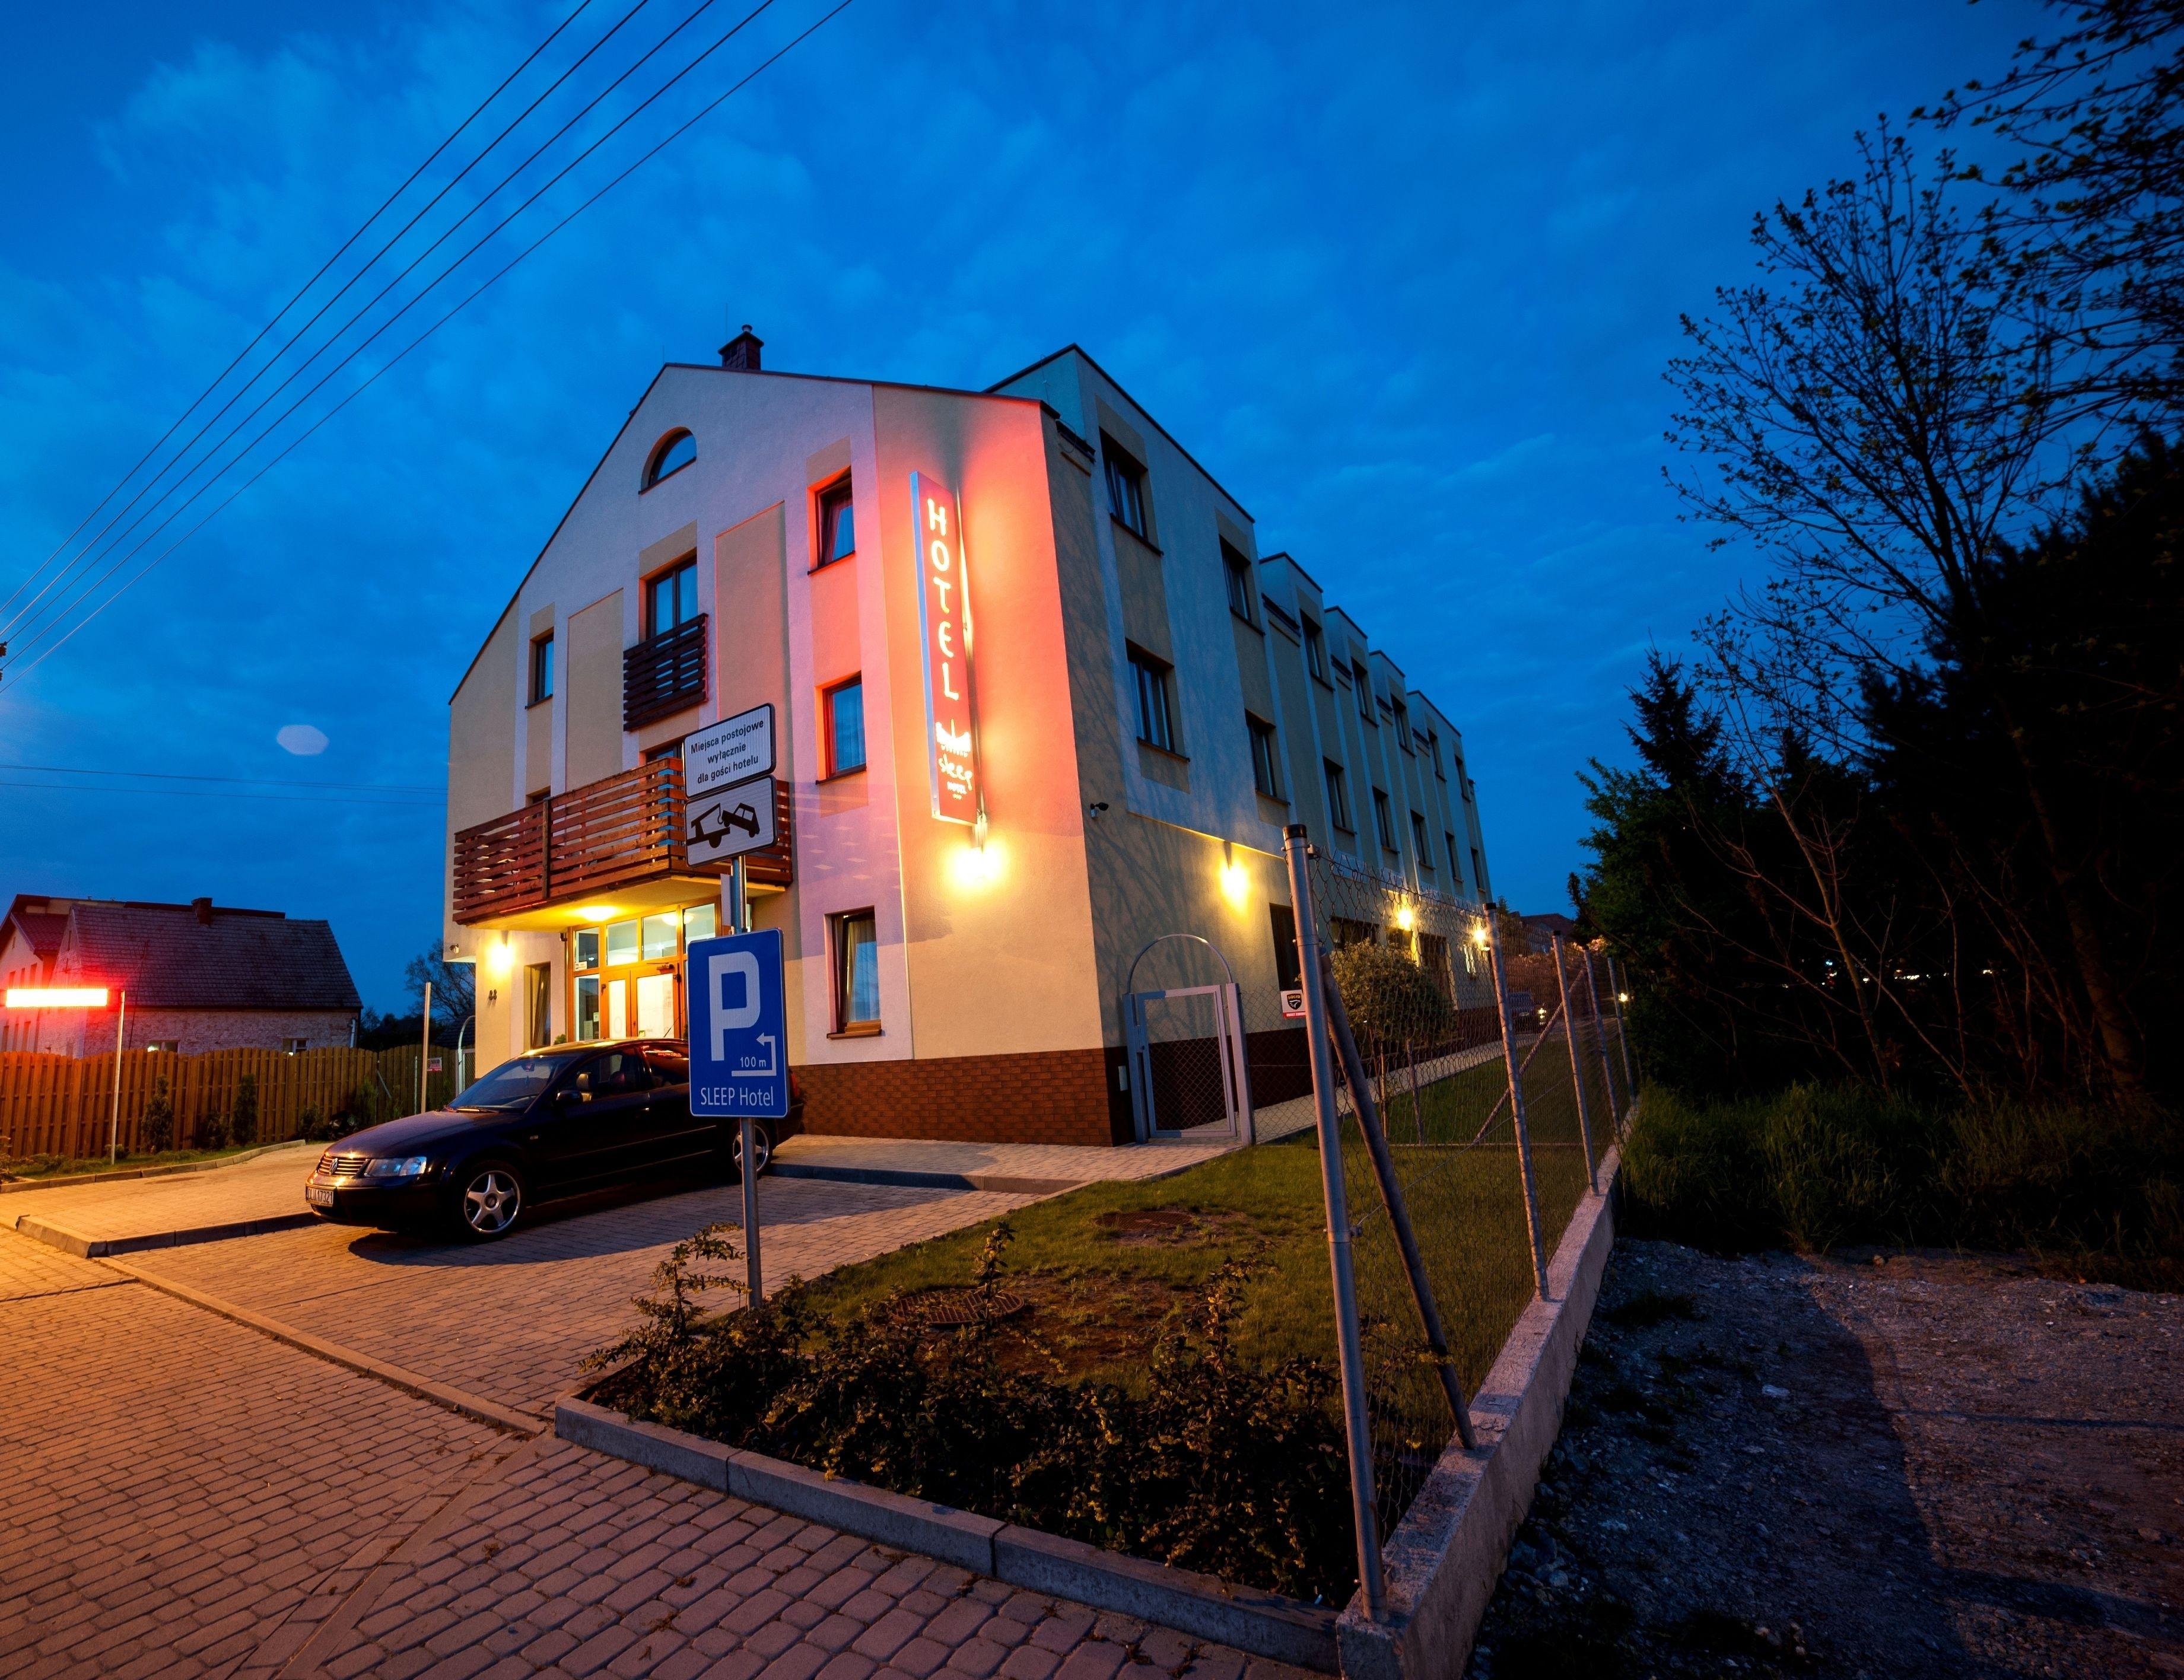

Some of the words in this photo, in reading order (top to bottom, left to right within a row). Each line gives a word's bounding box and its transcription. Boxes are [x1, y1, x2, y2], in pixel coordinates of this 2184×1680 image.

[927, 498, 959, 701] HOTEL
[691, 738, 719, 754] Miejsca
[721, 720, 764, 744] postojowe
[707, 743, 746, 764] wyłącznie
[697, 773, 708, 784] dla
[711, 763, 731, 781] gości
[733, 755, 759, 771] hotelu
[708, 950, 761, 1061] P
[740, 1057, 756, 1068] 100
[759, 1059, 767, 1067] m
[701, 1087, 735, 1106] SLEEP
[739, 1086, 774, 1106] Hotel
